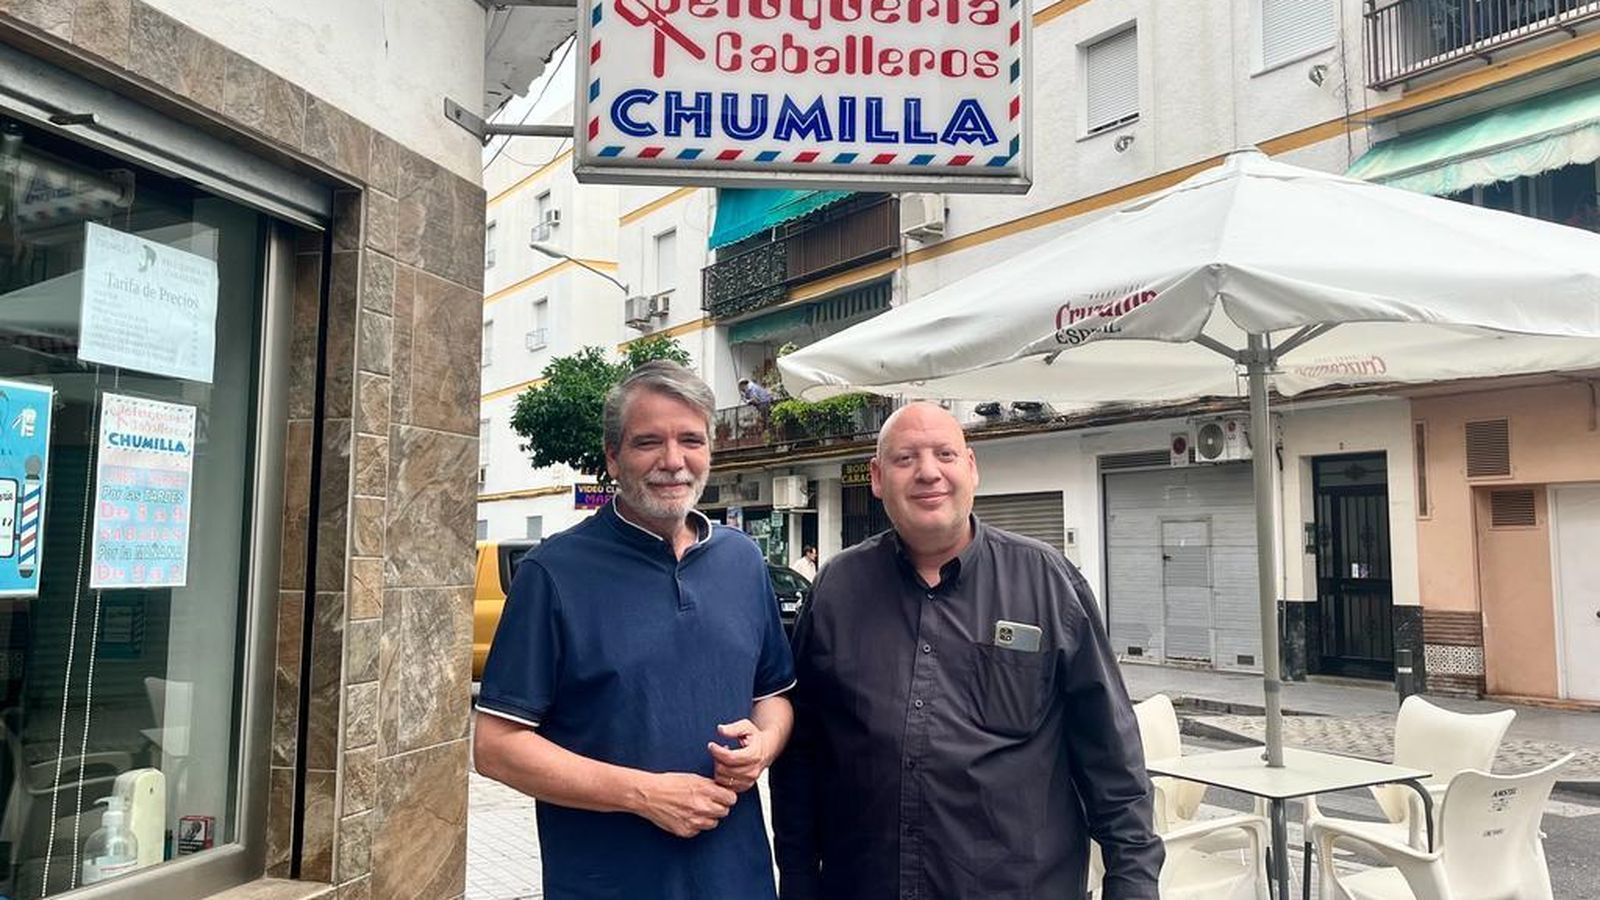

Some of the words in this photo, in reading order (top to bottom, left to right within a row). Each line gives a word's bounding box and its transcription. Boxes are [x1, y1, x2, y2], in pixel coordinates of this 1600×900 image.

[716, 31, 1000, 79] Caballeros
[610, 88, 998, 147] CHUMILLA
[105, 272, 140, 295] Tarifa
[143, 282, 157, 299] de
[160, 286, 199, 309] Precios
[108, 432, 187, 452] CHUMILLA
[577, 485, 604, 493] VIDEO
